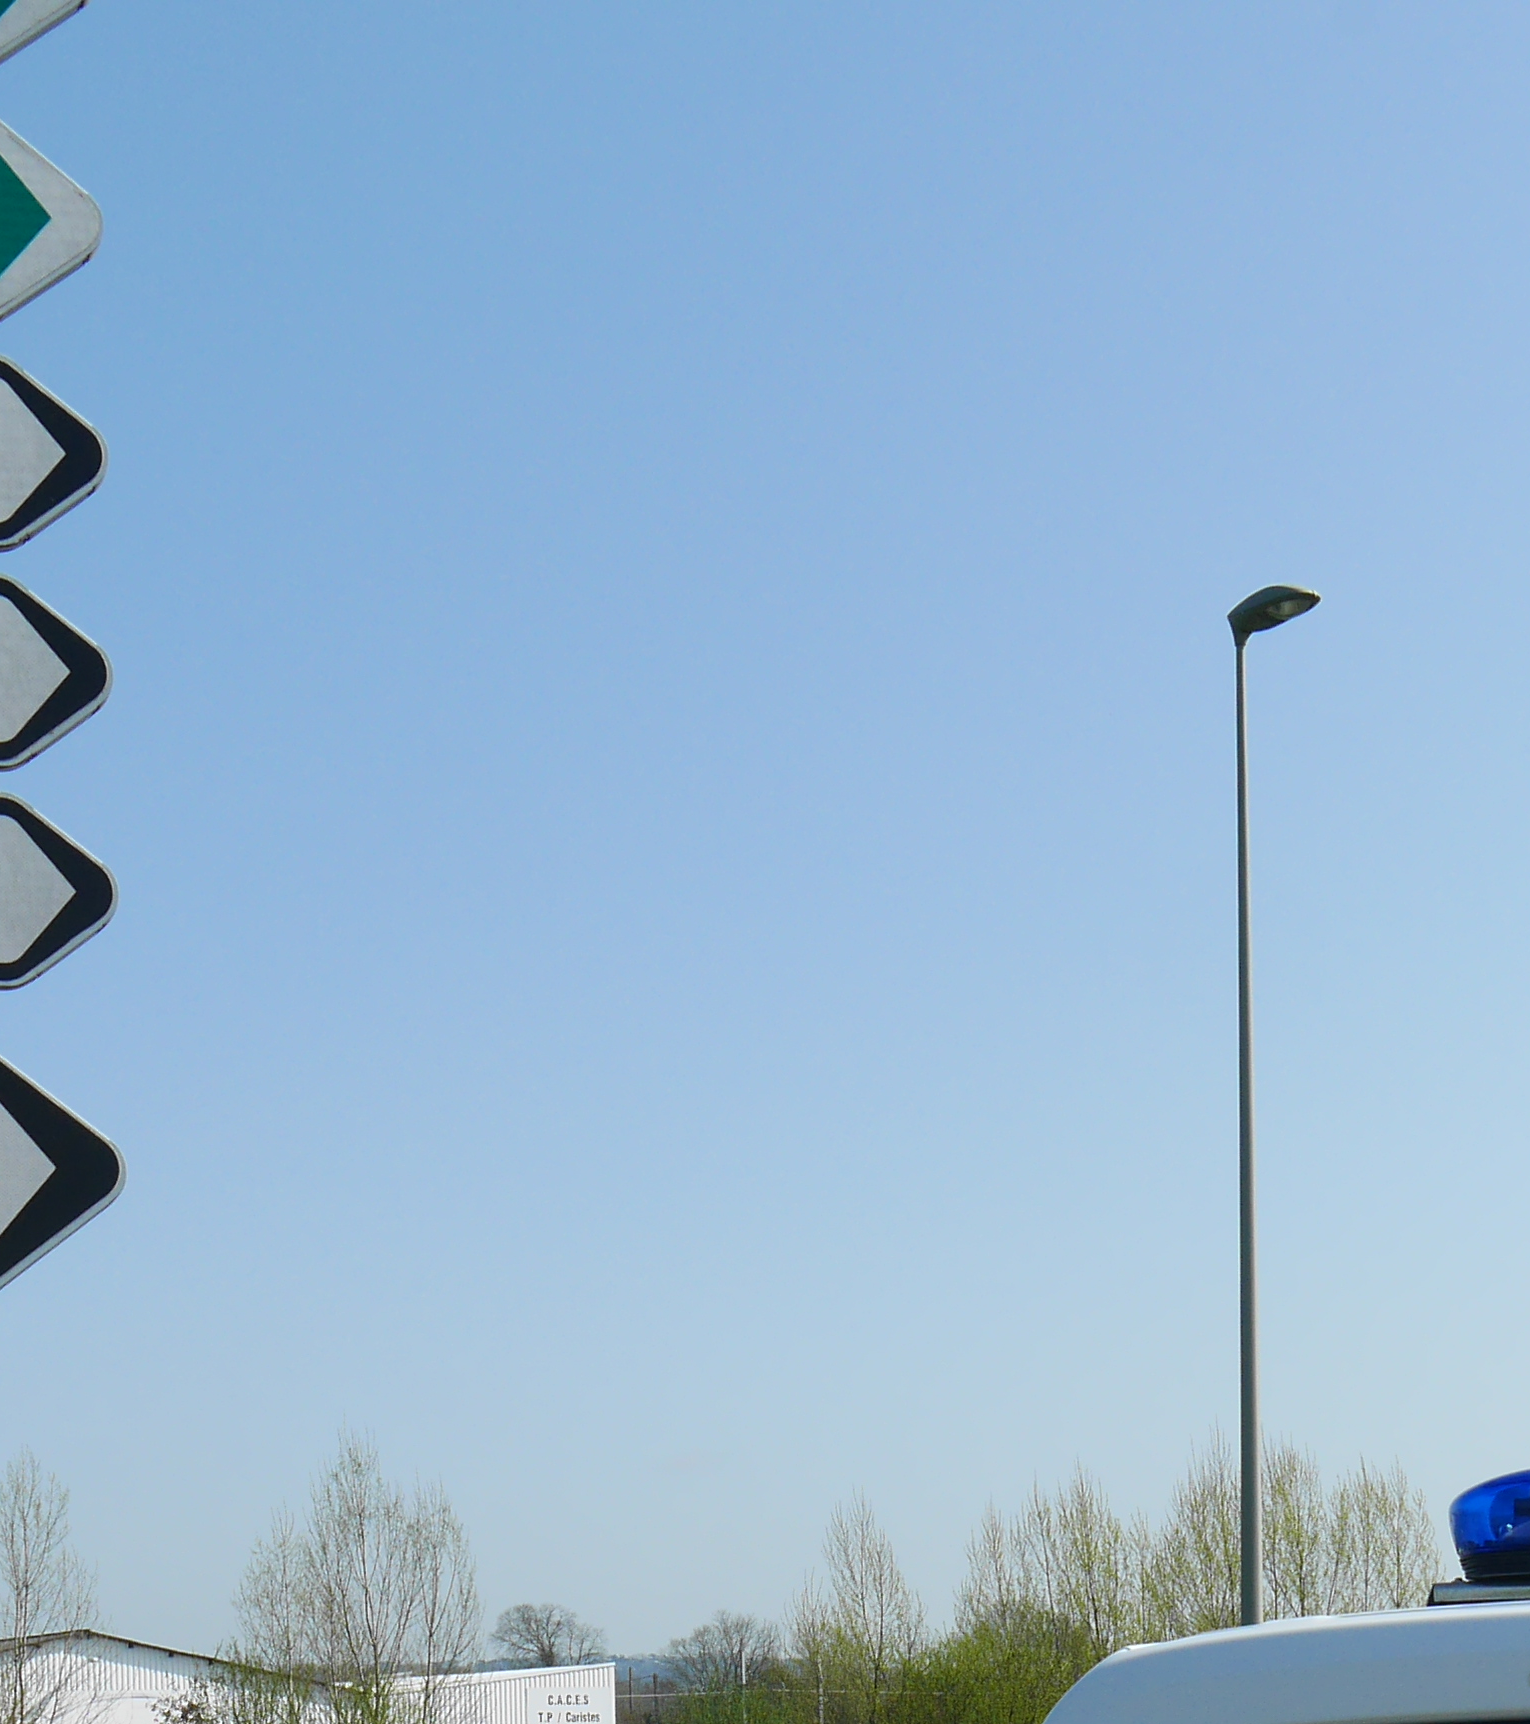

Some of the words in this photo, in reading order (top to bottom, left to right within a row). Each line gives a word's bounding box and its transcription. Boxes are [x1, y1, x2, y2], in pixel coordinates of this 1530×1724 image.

[548, 1694, 589, 1705] C.A.C.E.S
[538, 1712, 553, 1722] T.P
[566, 1711, 601, 1722] Caristes
